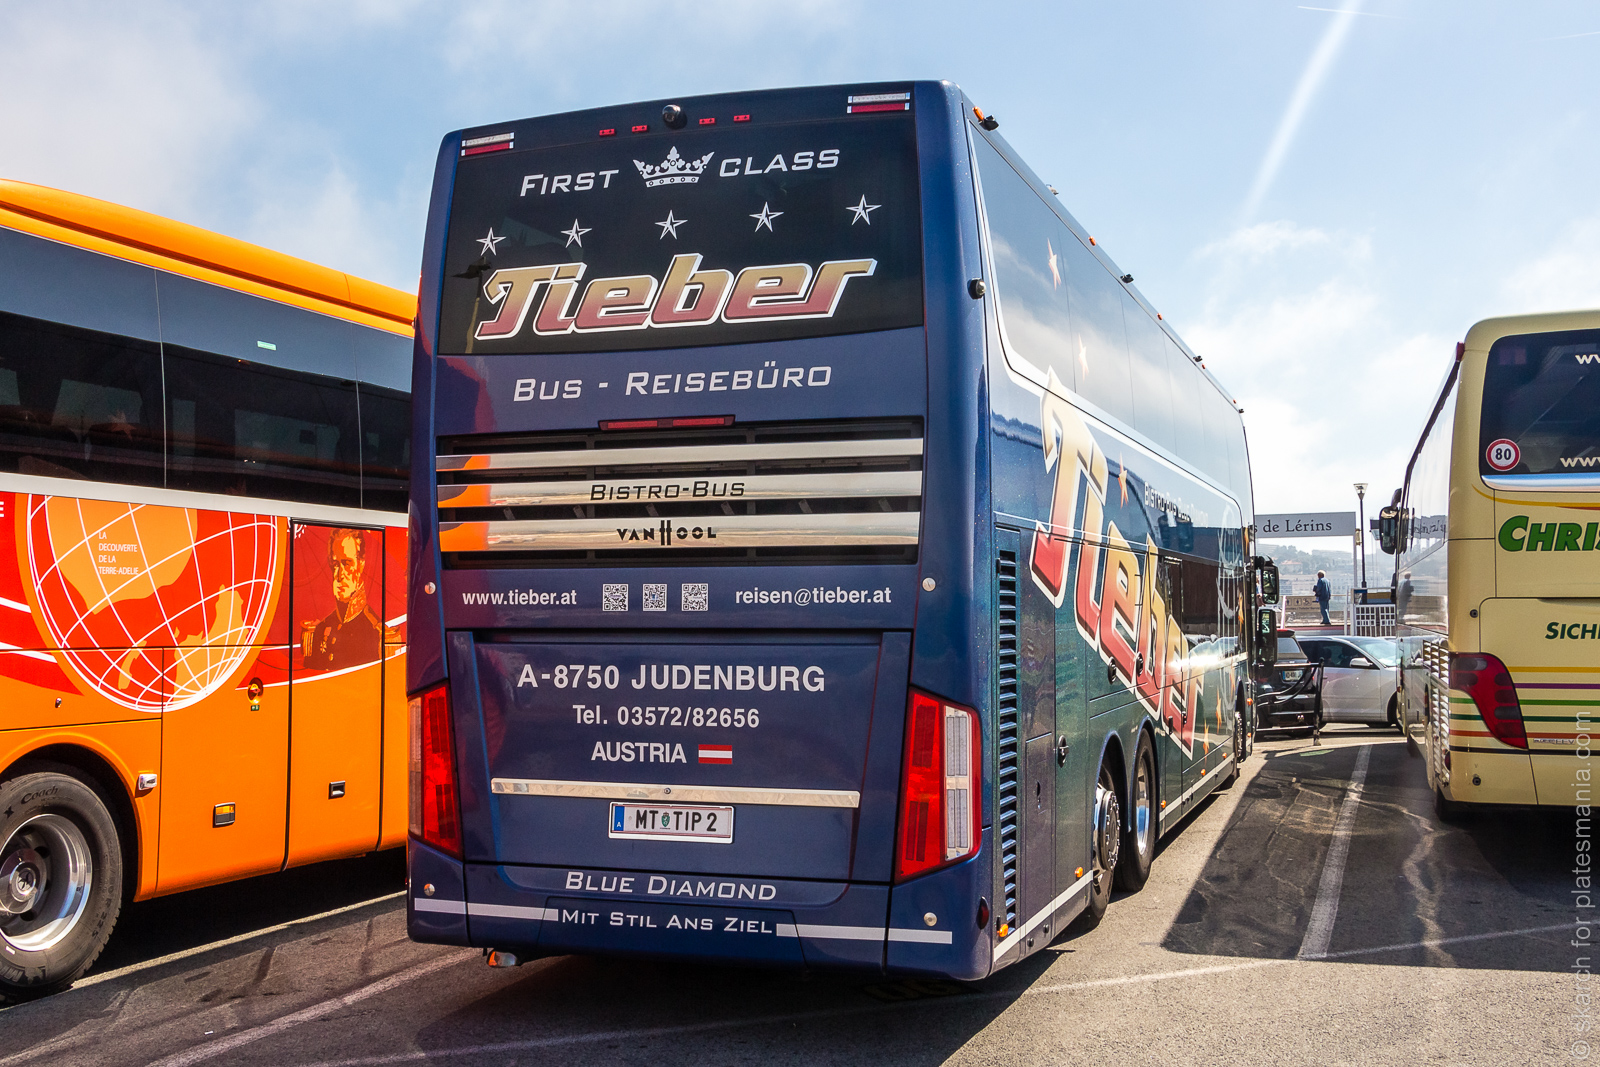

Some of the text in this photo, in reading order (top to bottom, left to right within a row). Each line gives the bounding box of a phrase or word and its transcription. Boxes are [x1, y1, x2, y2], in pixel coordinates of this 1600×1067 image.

[718, 148, 840, 178] CLASS
[474, 252, 878, 341] Tieber
[1494, 447, 1512, 461] 80
[98, 531, 108, 540] LA
[1262, 519, 1280, 533] de
[1285, 519, 1332, 533] Lérins
[1498, 515, 1600, 552] CHRI
[98, 543, 138, 552] DECOUVERTE
[98, 555, 116, 563] DE LA
[98, 566, 139, 575] TERRE-ADELIE
[462, 587, 577, 606] www.tieber.at
[735, 586, 892, 607] reisen@tieber.at
[1545, 621, 1600, 640] SICH
[517, 664, 825, 693] A-8750 JUDENBURG
[573, 704, 760, 729] Tel. 03572/82656
[591, 741, 687, 764] AUSTRIA
[635, 809, 659, 830] MT
[673, 811, 702, 831] TIP
[706, 812, 717, 832] 2
